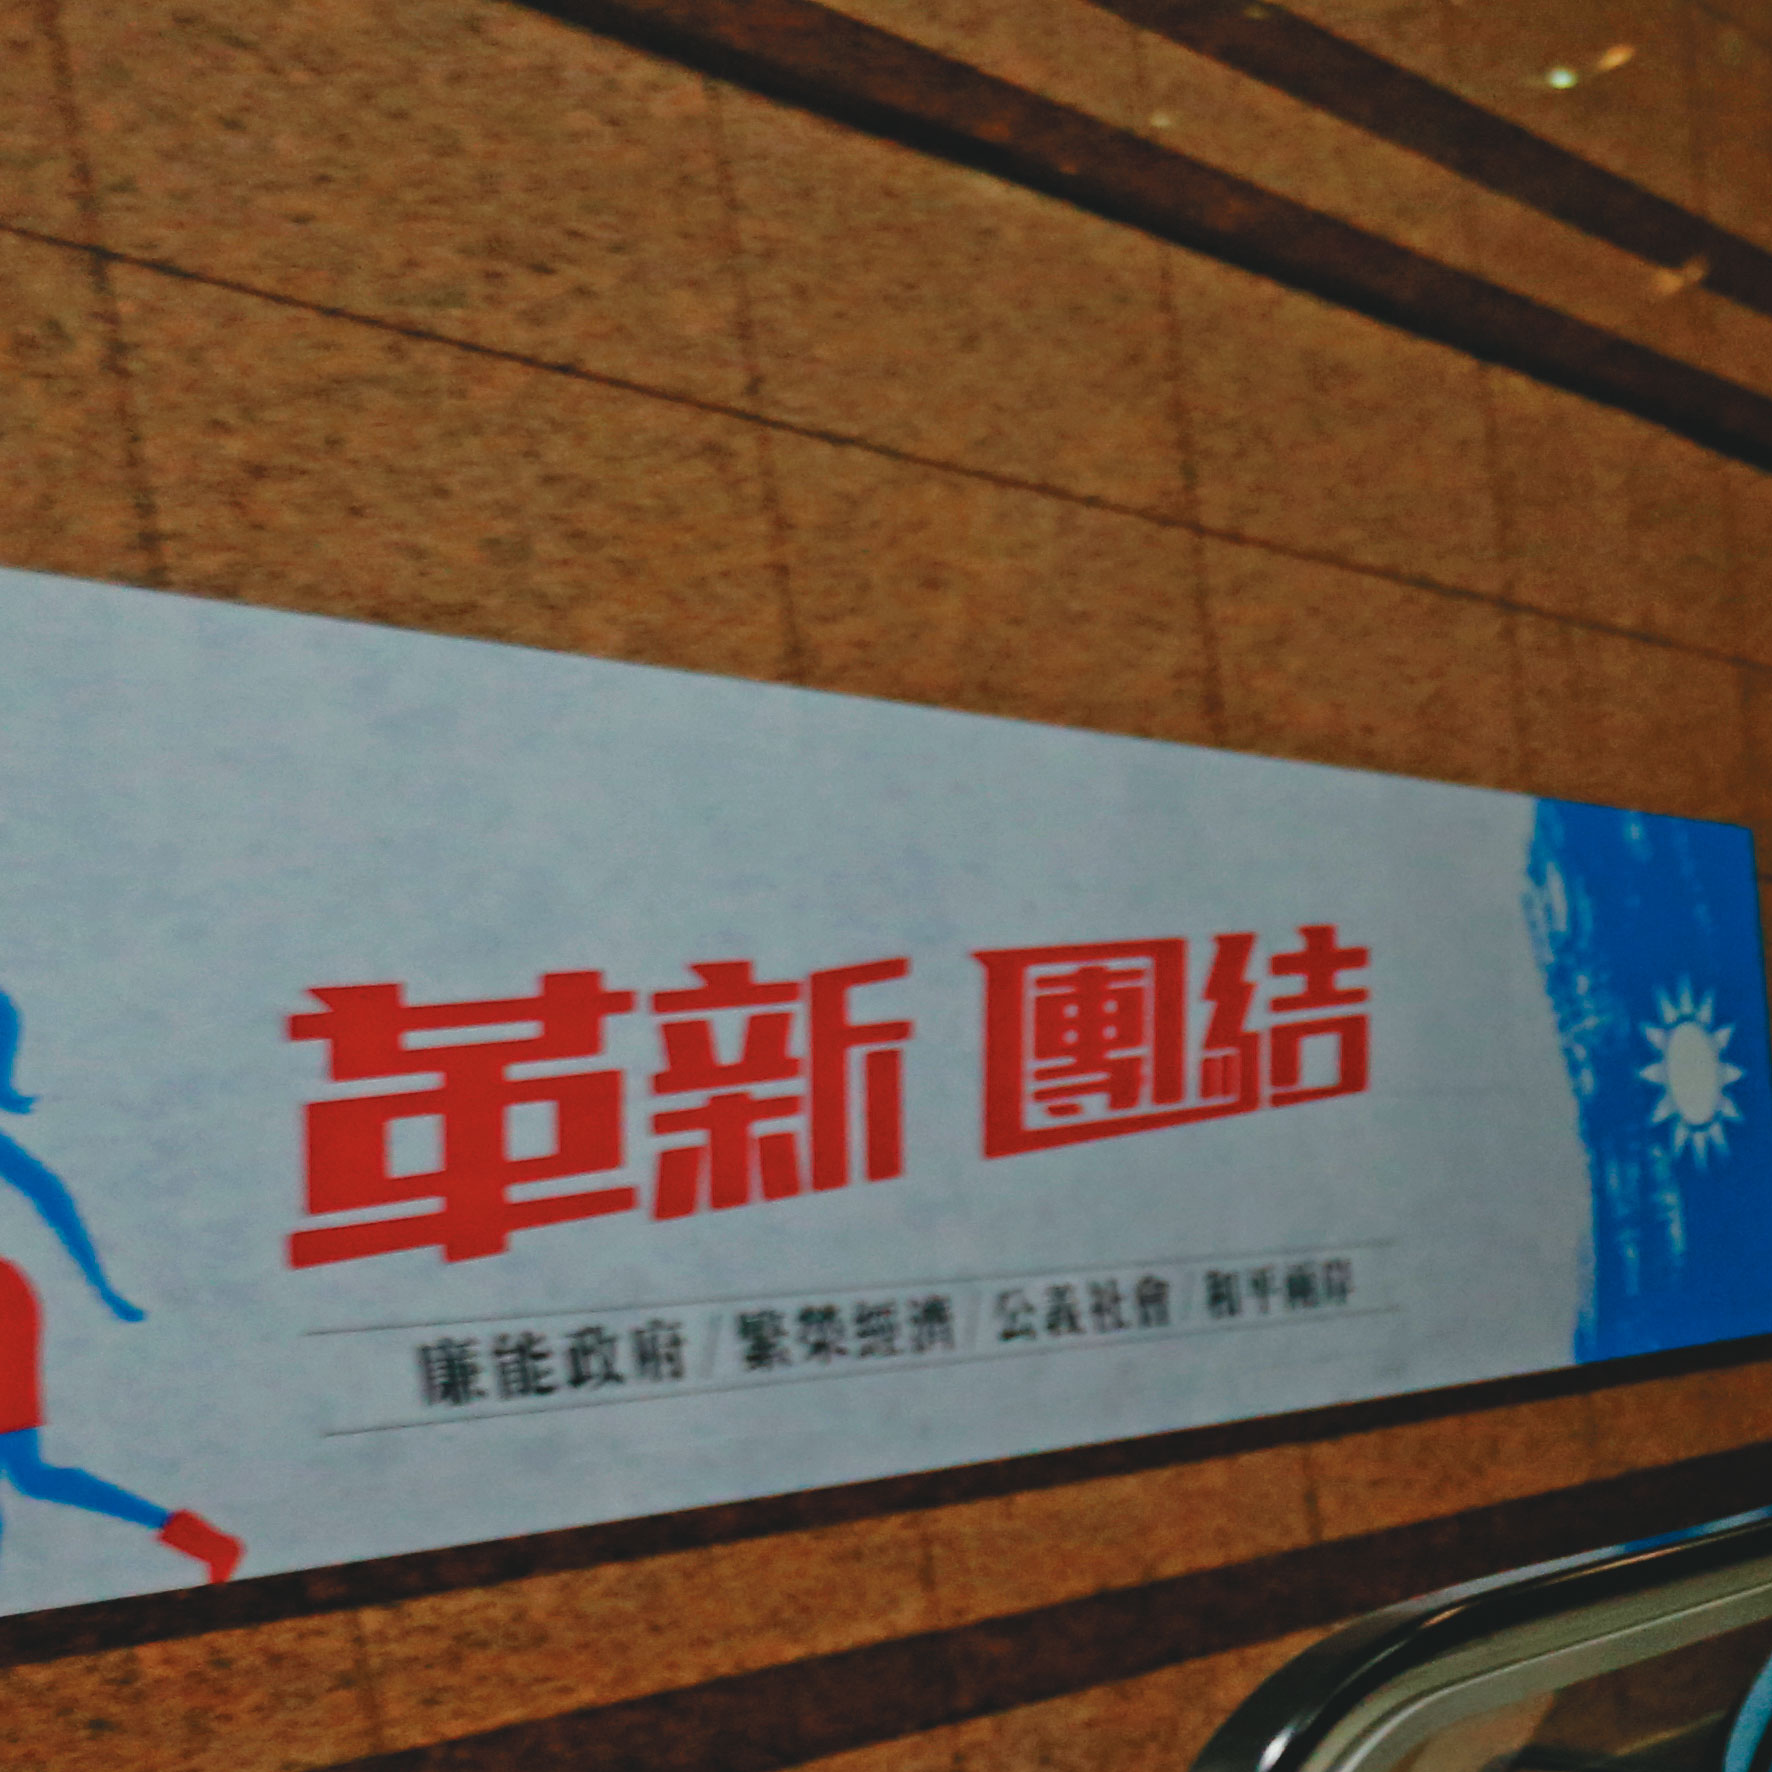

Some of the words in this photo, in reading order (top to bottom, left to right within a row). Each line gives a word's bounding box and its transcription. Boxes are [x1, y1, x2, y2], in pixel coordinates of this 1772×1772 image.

[286, 956, 913, 1270] 革新
[972, 923, 1371, 1160] 團結
[415, 1317, 686, 1405] 廉能政府
